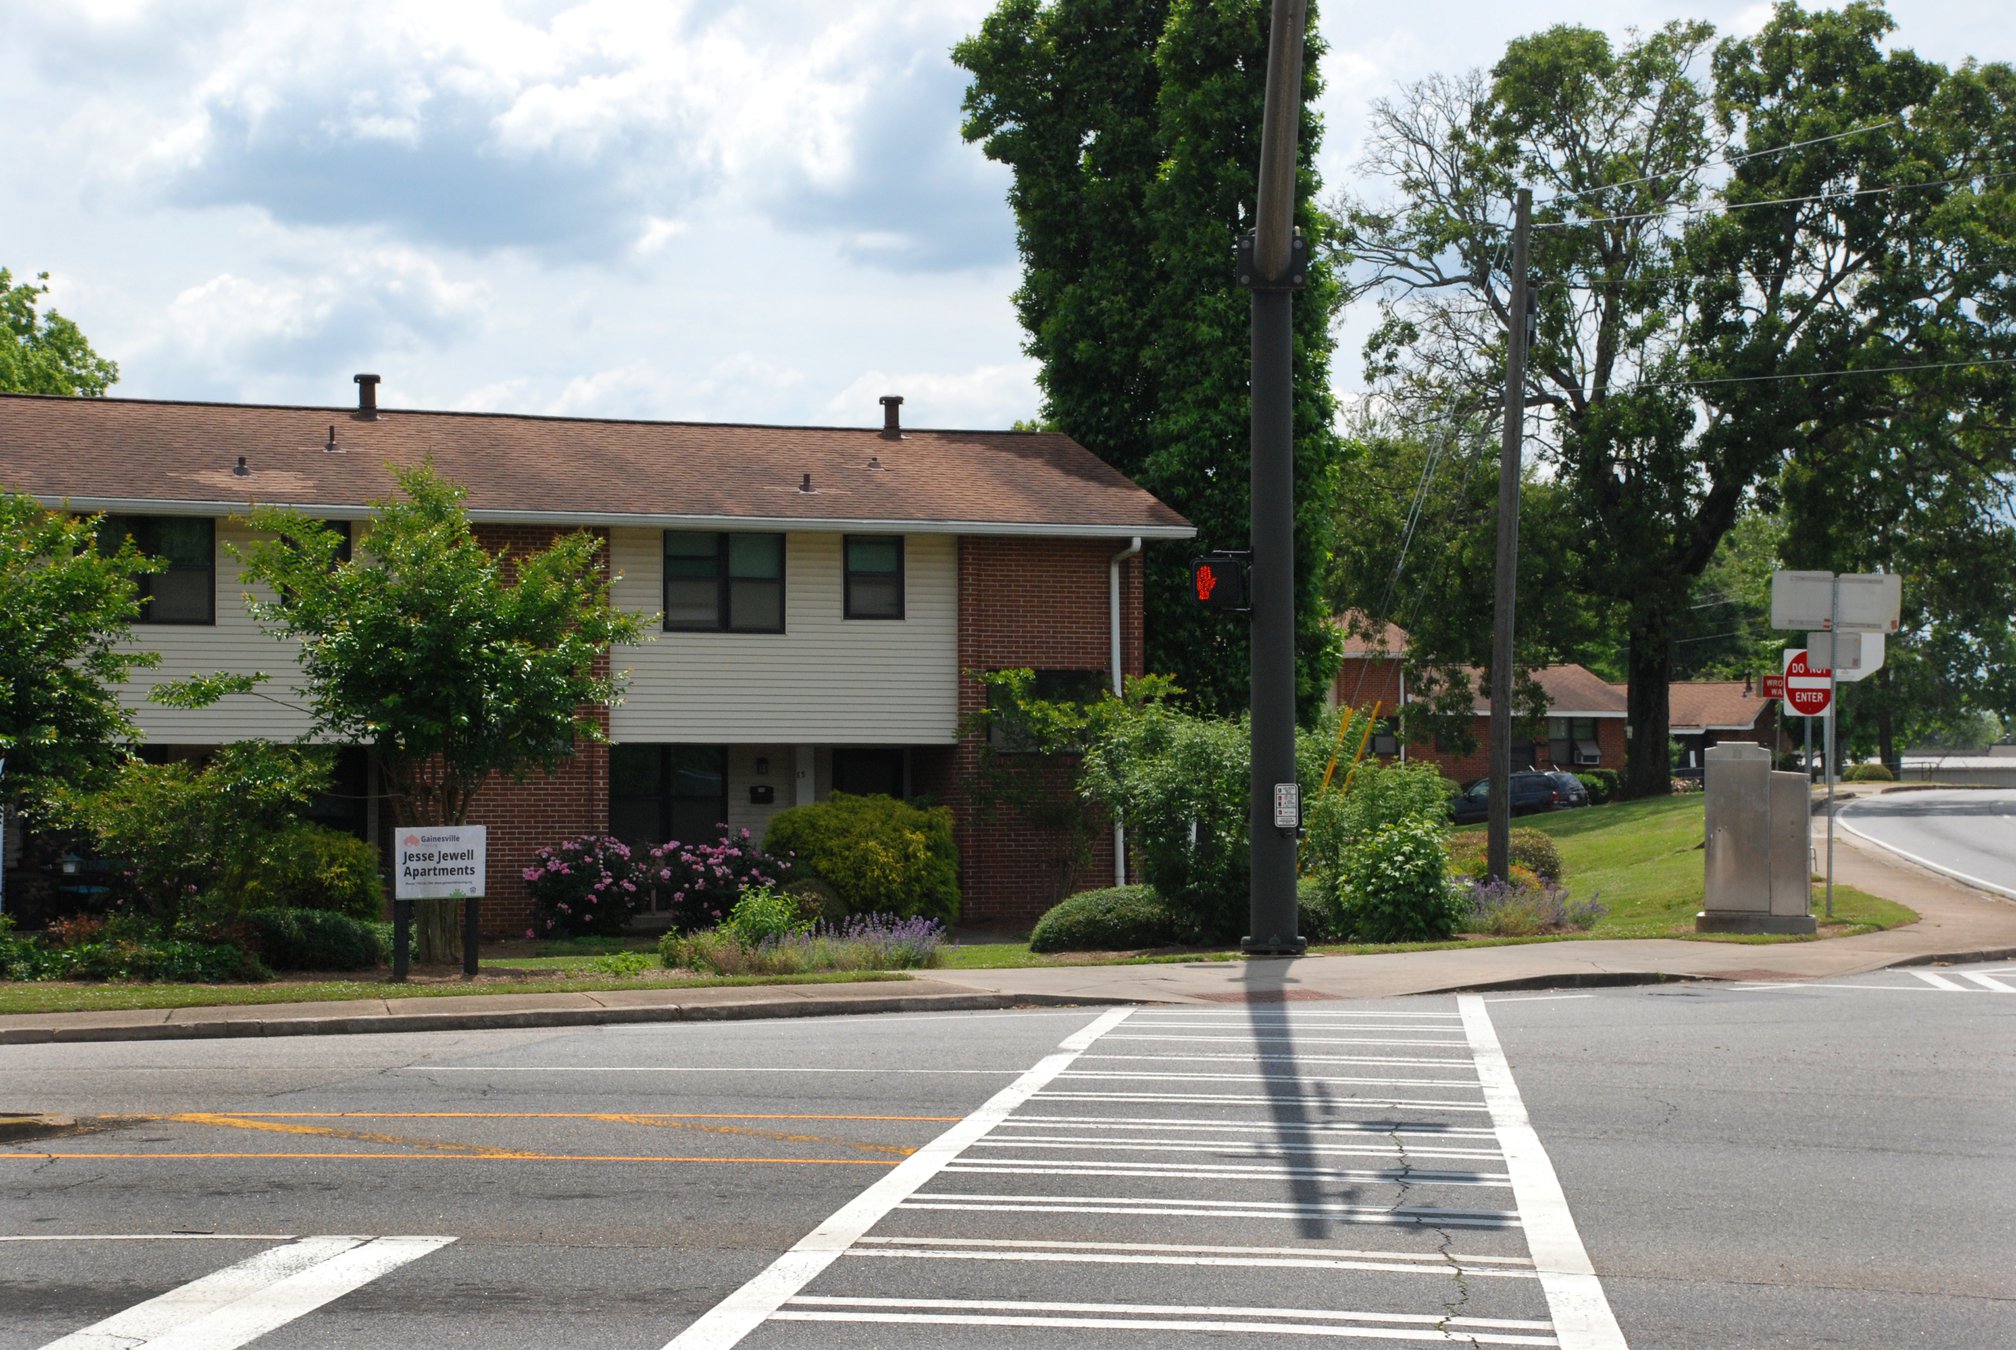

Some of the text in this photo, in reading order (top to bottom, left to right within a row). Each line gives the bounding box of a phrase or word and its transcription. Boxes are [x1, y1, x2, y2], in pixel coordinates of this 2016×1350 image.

[1792, 663, 1805, 674] DO
[1766, 679, 1783, 688] WRO
[1771, 688, 1783, 696] WA
[1795, 691, 1824, 703] ENTER
[420, 834, 461, 843] Gainesville
[402, 849, 474, 865] Jesse Jewell
[403, 865, 476, 880] Apartments
